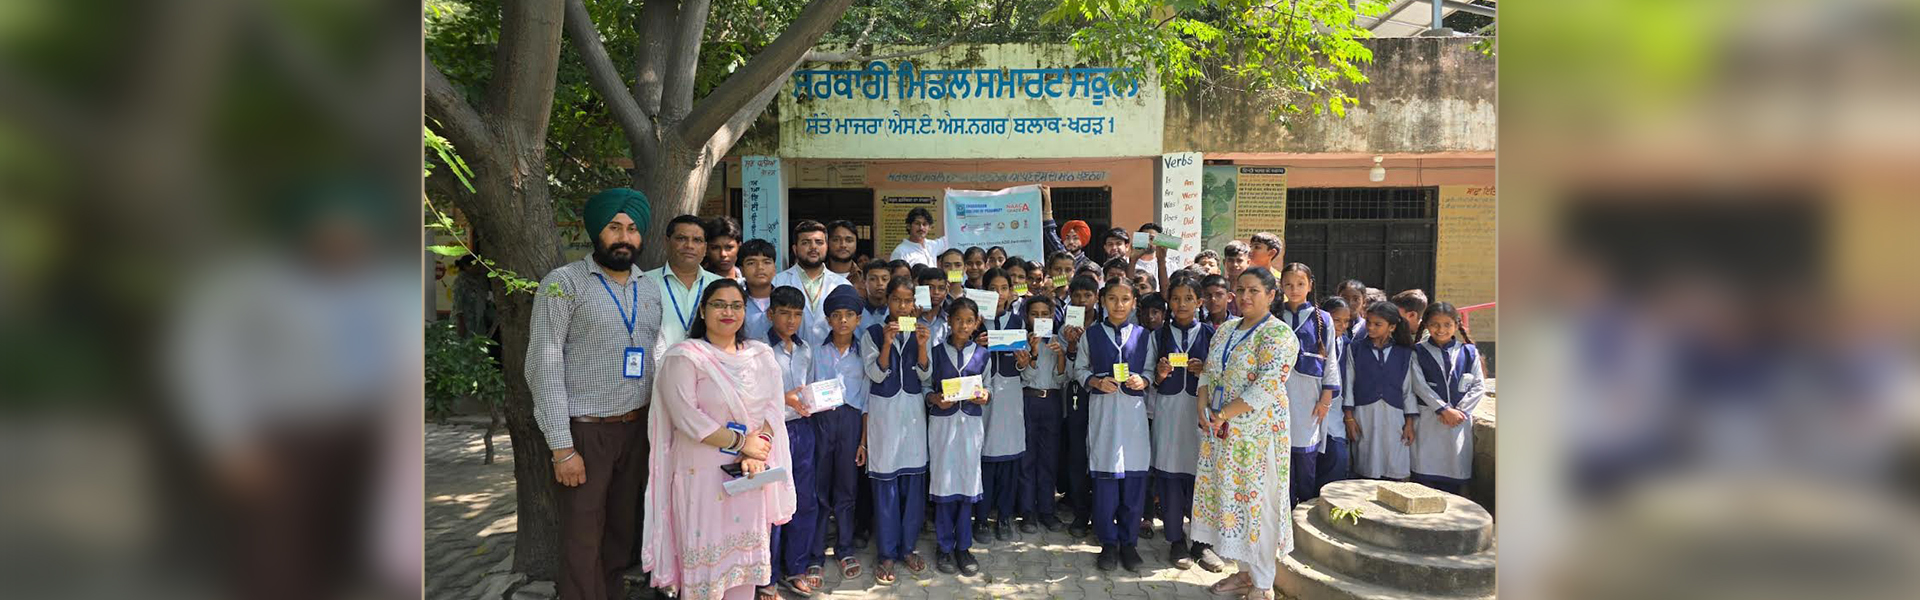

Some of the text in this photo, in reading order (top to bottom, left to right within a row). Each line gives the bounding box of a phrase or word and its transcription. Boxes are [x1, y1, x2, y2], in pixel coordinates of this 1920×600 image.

[793, 59, 1139, 106] ਸਰਕਾਰੀ ਮਿਡਲ ਸਮਾਰਟ ਸਕੂਲ
[835, 117, 884, 135] ਮਾਜਰਾ
[1108, 116, 1114, 134] 1
[1164, 153, 1193, 169] Verbs
[1183, 216, 1195, 226] Did
